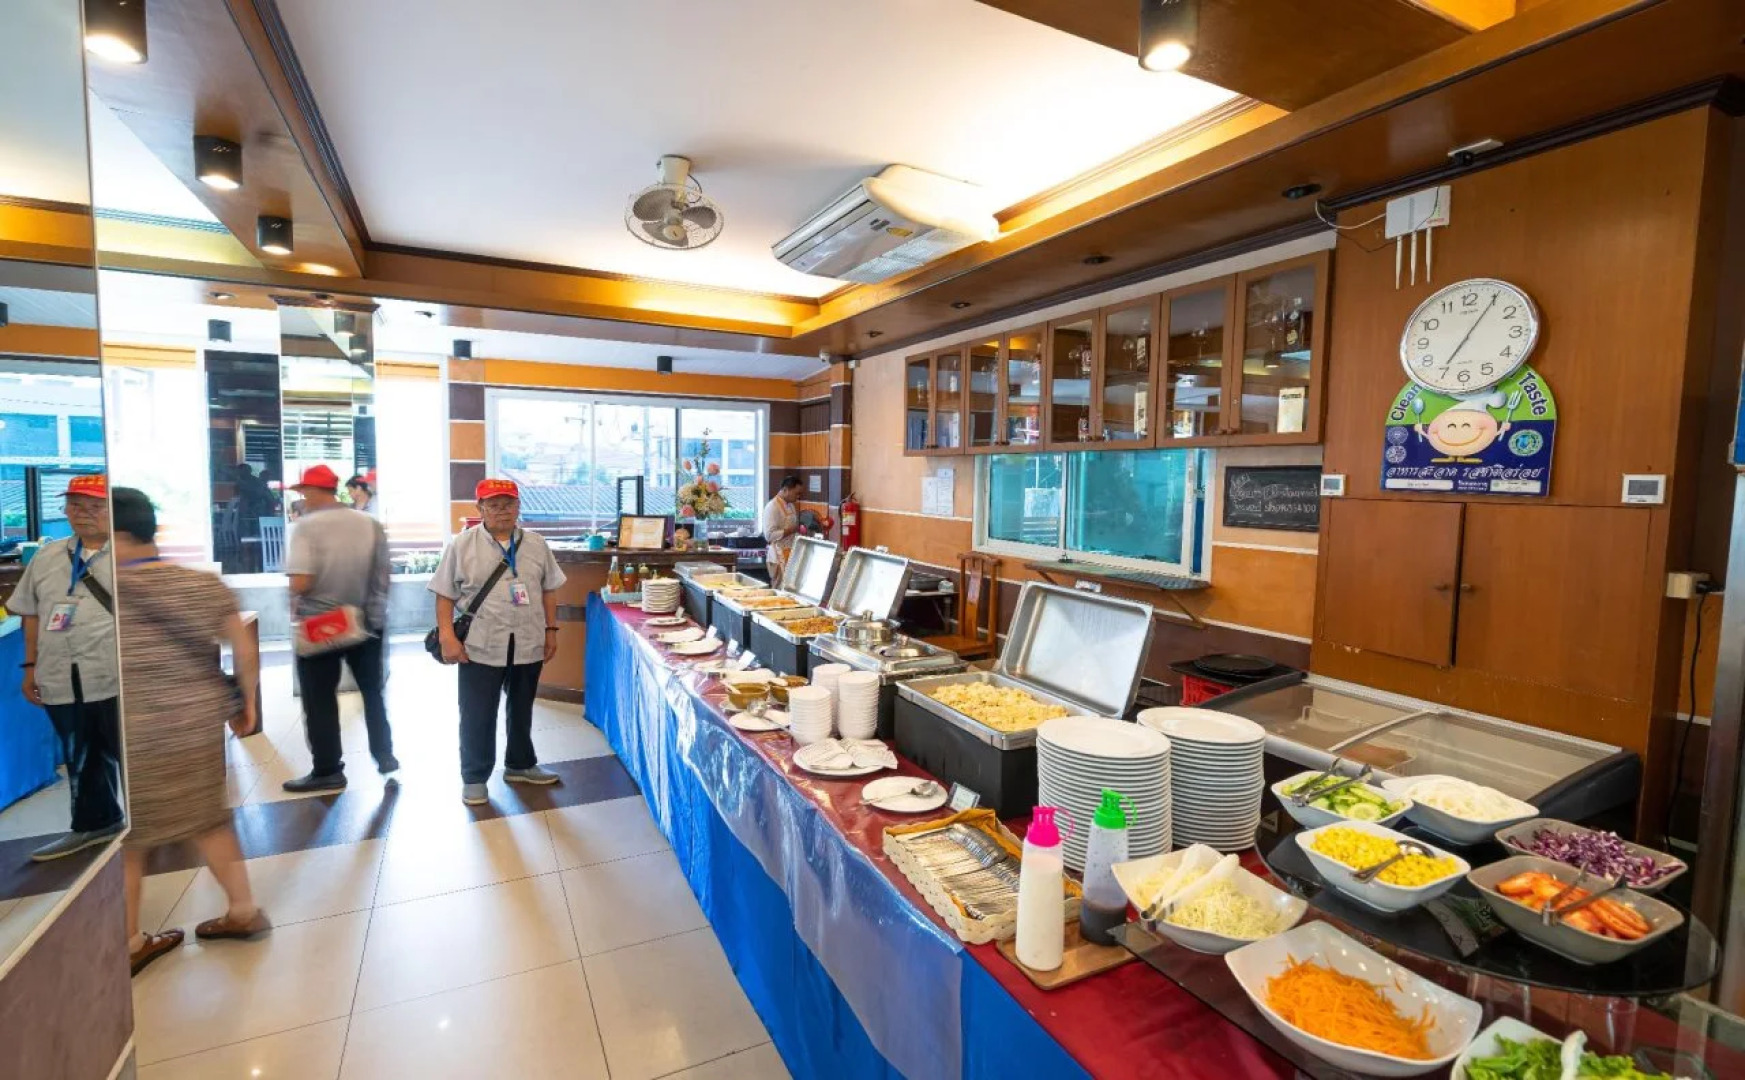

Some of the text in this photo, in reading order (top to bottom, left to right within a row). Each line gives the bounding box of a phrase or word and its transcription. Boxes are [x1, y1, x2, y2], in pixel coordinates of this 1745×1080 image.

[1461, 292, 1479, 307] 12
[1441, 301, 1453, 314] 11
[1502, 305, 1517, 320] 2
[1420, 318, 1440, 331] 10
[1508, 325, 1523, 339] 3
[1417, 337, 1430, 350] 9
[1499, 344, 1512, 358] 4
[1421, 354, 1434, 368] 8
[1438, 366, 1450, 380] 7
[1480, 362, 1494, 376] 5
[1456, 370, 1471, 383] 6
[1518, 371, 1549, 417] Taste
[1390, 384, 1423, 422] Clean
